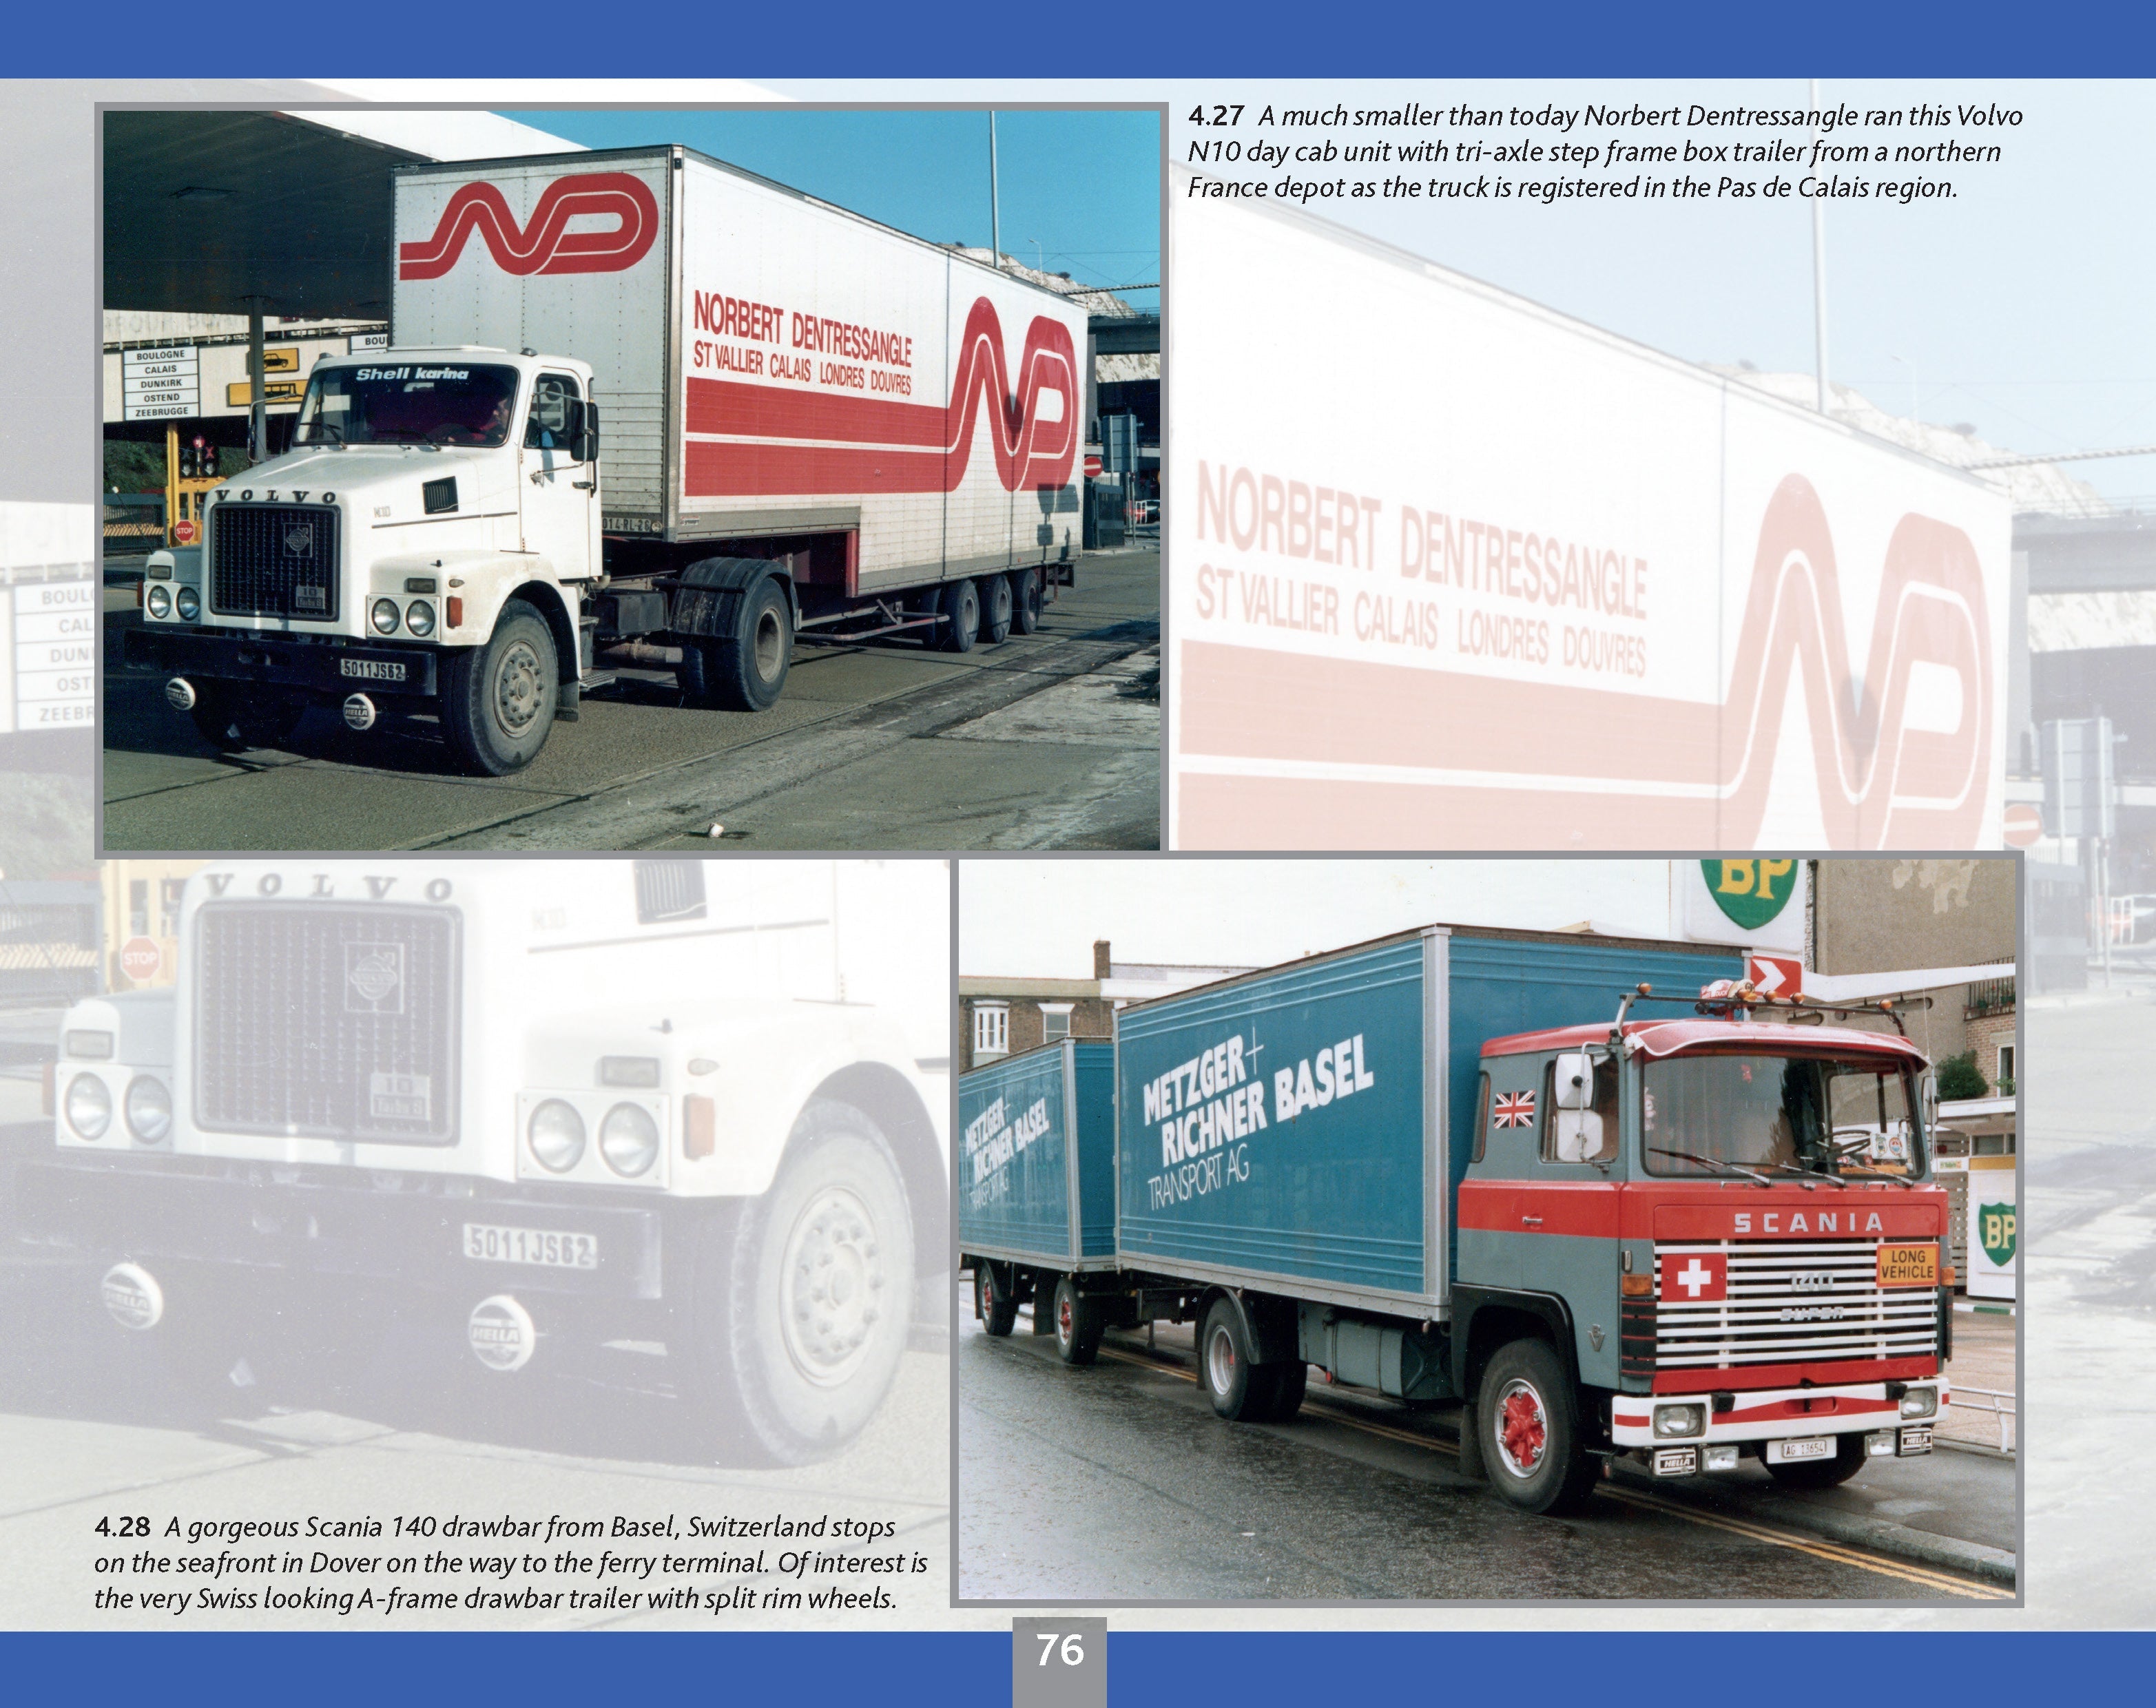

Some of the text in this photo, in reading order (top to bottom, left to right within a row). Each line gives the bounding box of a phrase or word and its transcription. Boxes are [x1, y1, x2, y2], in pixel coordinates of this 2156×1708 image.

[694, 289, 913, 368] NORBERT DENTRESSANGLE
[136, 350, 185, 360] BOULOGNE
[145, 364, 177, 375] CALAIS
[356, 366, 470, 381] Shell karina
[694, 340, 912, 396] ST VALLIER CALAIS LONDRES DOUVRES
[141, 378, 183, 388] DUNKIRK
[144, 393, 180, 402] OSTEND
[135, 406, 189, 417] ZEEBRUGGE
[215, 489, 337, 505] VOLVO
[176, 527, 194, 535] STOP
[1196, 459, 1648, 621] NORBERT DENTRESSANGLE
[1195, 563, 1647, 680] ST VALLIER CALAIS LONDRES DOUVRES
[344, 660, 402, 680] 5011JS62
[167, 691, 188, 701] HELLA
[205, 873, 453, 904] VOLVO
[124, 952, 158, 966] STOP
[1161, 1033, 1375, 1168] RICHNER BASEL
[973, 1097, 1050, 1185] RICHNER BASEL
[1148, 1143, 1250, 1211] TRANSPORT AG
[1734, 1212, 1883, 1233] SCANIA
[1984, 1214, 2015, 1249] BP
[471, 1227, 592, 1266] 5011JS62
[1891, 1249, 1926, 1263] LONG
[1881, 1264, 1934, 1279] VEHICLE
[1789, 1271, 1834, 1292] 140
[1780, 1306, 1845, 1322] SUPER
[473, 1326, 521, 1343] HELLA
[1905, 1435, 1929, 1445] HELLA
[1785, 1446, 1796, 1456] AG
[1663, 1458, 1691, 1468] HELLA
